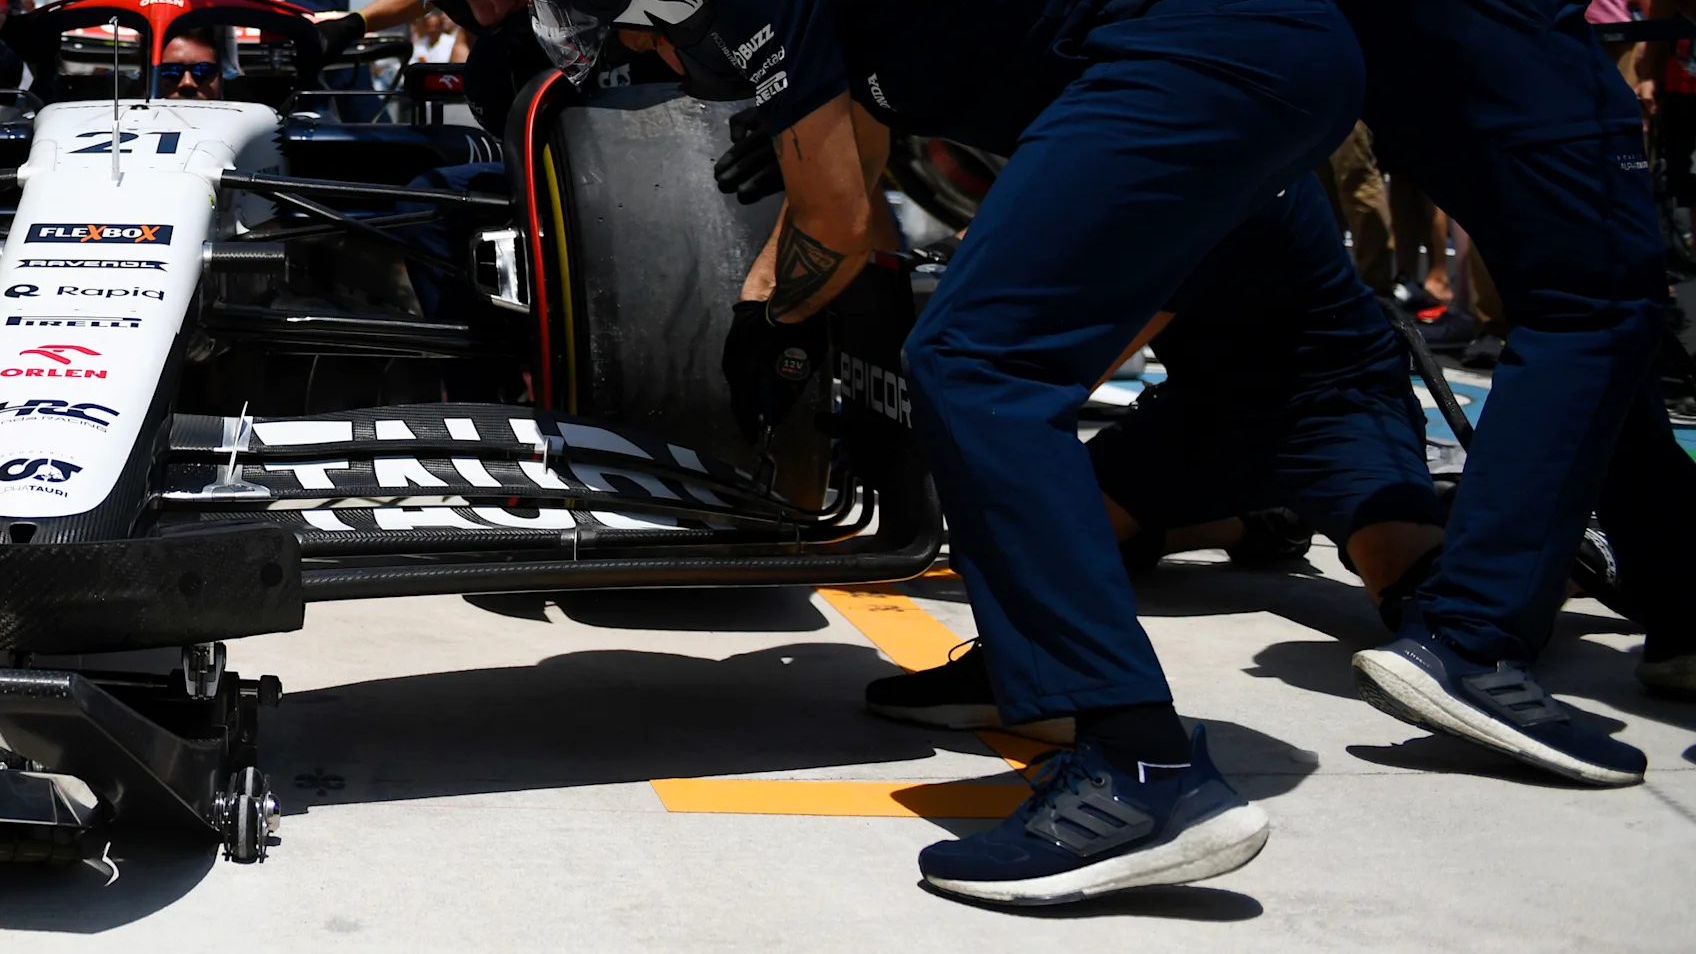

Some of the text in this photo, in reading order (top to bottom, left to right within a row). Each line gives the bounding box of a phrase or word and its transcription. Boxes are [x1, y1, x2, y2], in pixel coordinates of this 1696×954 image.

[738, 23, 775, 61] BUZZ
[867, 72, 893, 109] ONDA
[65, 131, 181, 154] 21
[38, 224, 161, 243] FLEXBOX
[25, 259, 160, 270] RAVENOL
[4, 315, 143, 329] PIRELLI
[784, 359, 804, 370] 12V
[0, 368, 108, 379] ORLEN
